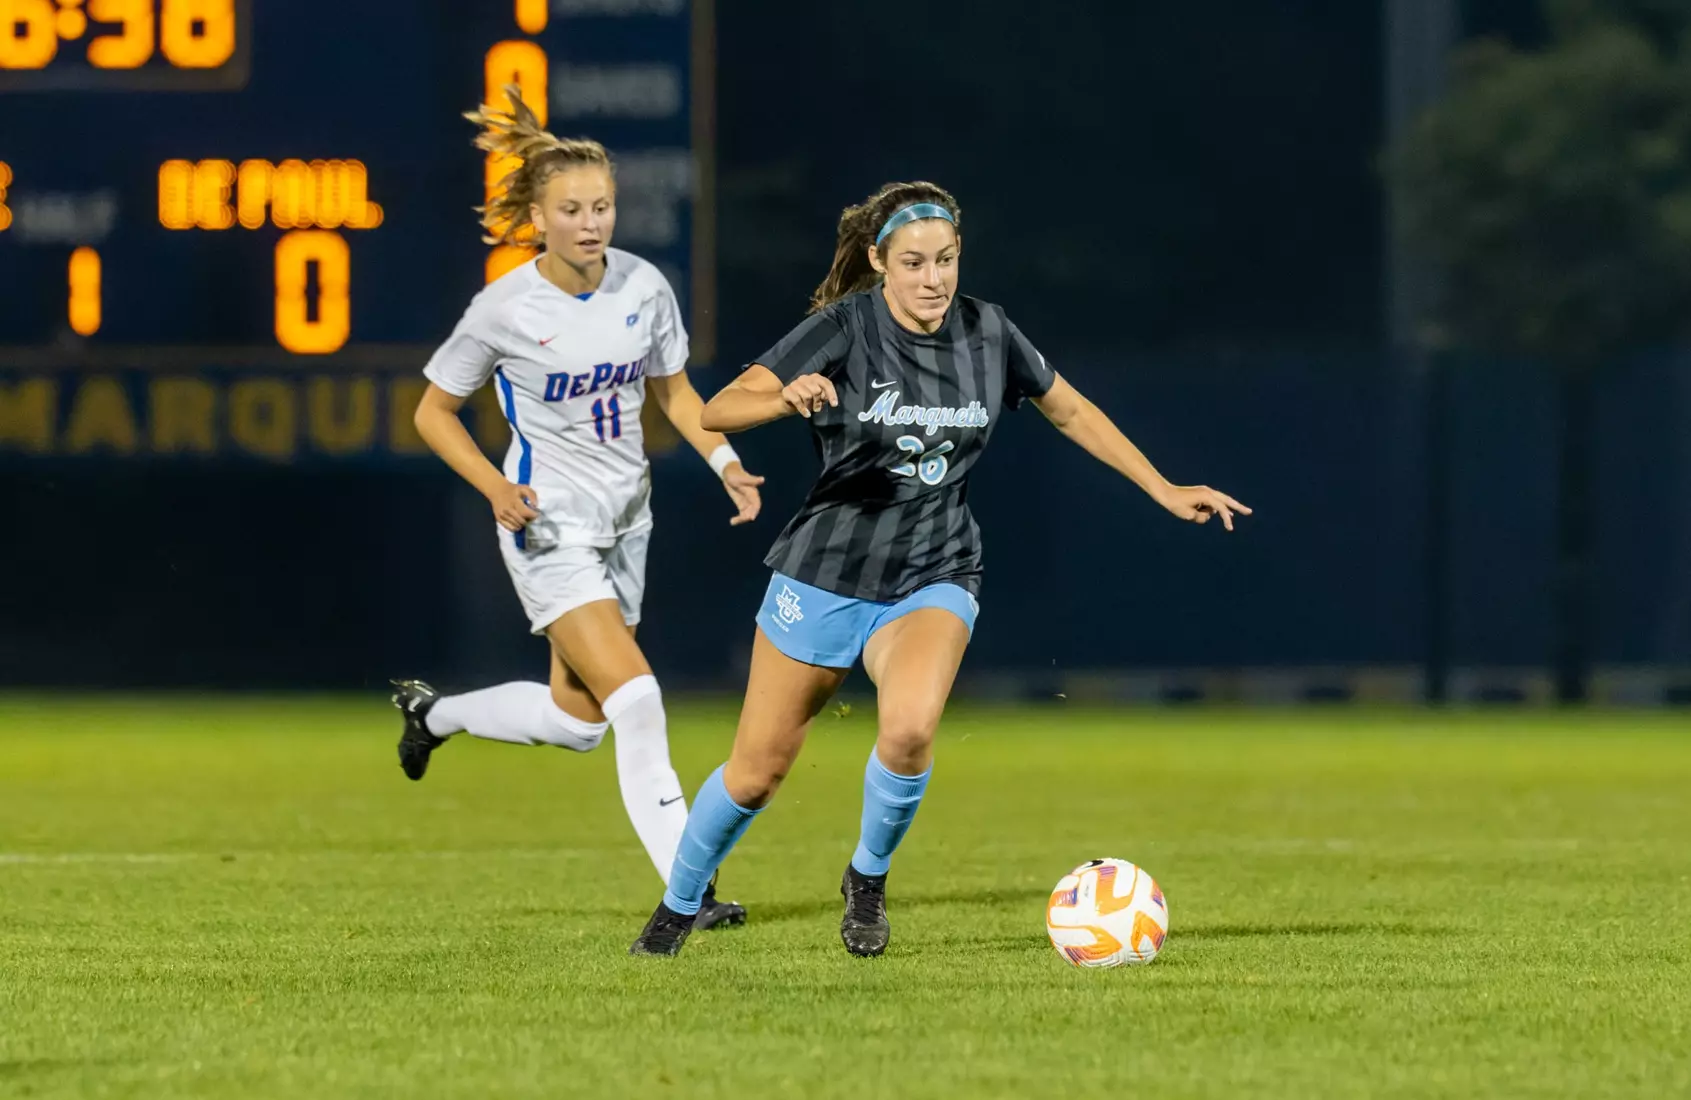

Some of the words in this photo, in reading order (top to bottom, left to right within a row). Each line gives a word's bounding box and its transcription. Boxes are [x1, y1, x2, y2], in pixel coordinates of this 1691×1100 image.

[68, 246, 101, 335] 1
[274, 229, 350, 353] 0
[590, 392, 621, 443] 11
[887, 435, 955, 486] 26
